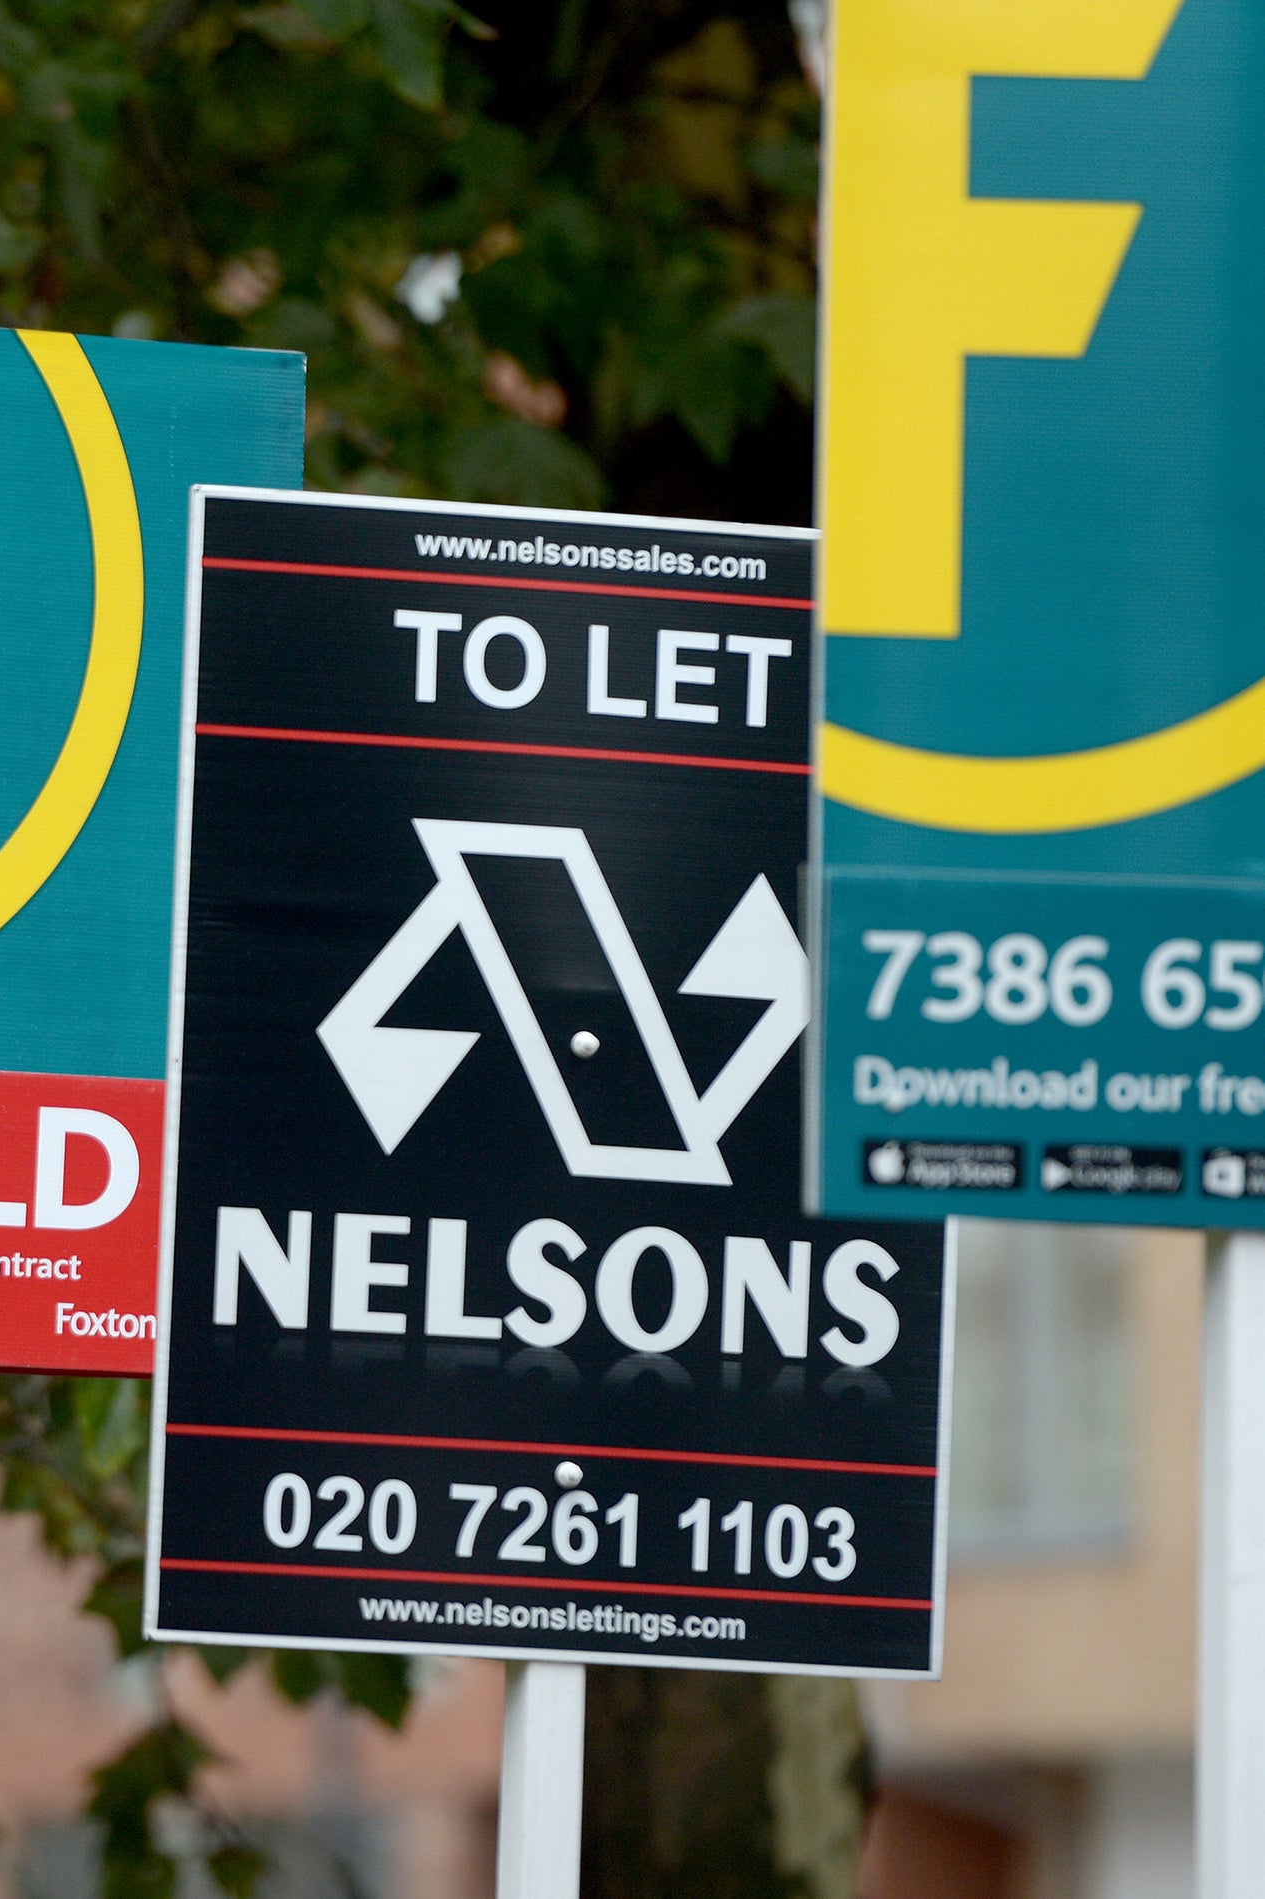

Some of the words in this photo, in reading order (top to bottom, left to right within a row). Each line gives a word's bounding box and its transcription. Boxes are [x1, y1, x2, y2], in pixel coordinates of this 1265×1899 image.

[415, 533, 766, 580] www.nelsonssales.com
[394, 609, 547, 710] TO
[587, 624, 793, 728] LET
[863, 930, 1113, 1027] 7386
[1140, 937, 1265, 1031] 65
[854, 1055, 1098, 1112] Download
[1106, 1072, 1191, 1113] our
[56, 1302, 156, 1338] Foxton
[213, 1206, 901, 1367] NELSONS
[263, 1472, 417, 1555] 020
[449, 1483, 639, 1566] 7261
[679, 1498, 857, 1582] 1103
[360, 1598, 746, 1643] www.nelsonslettings.com
